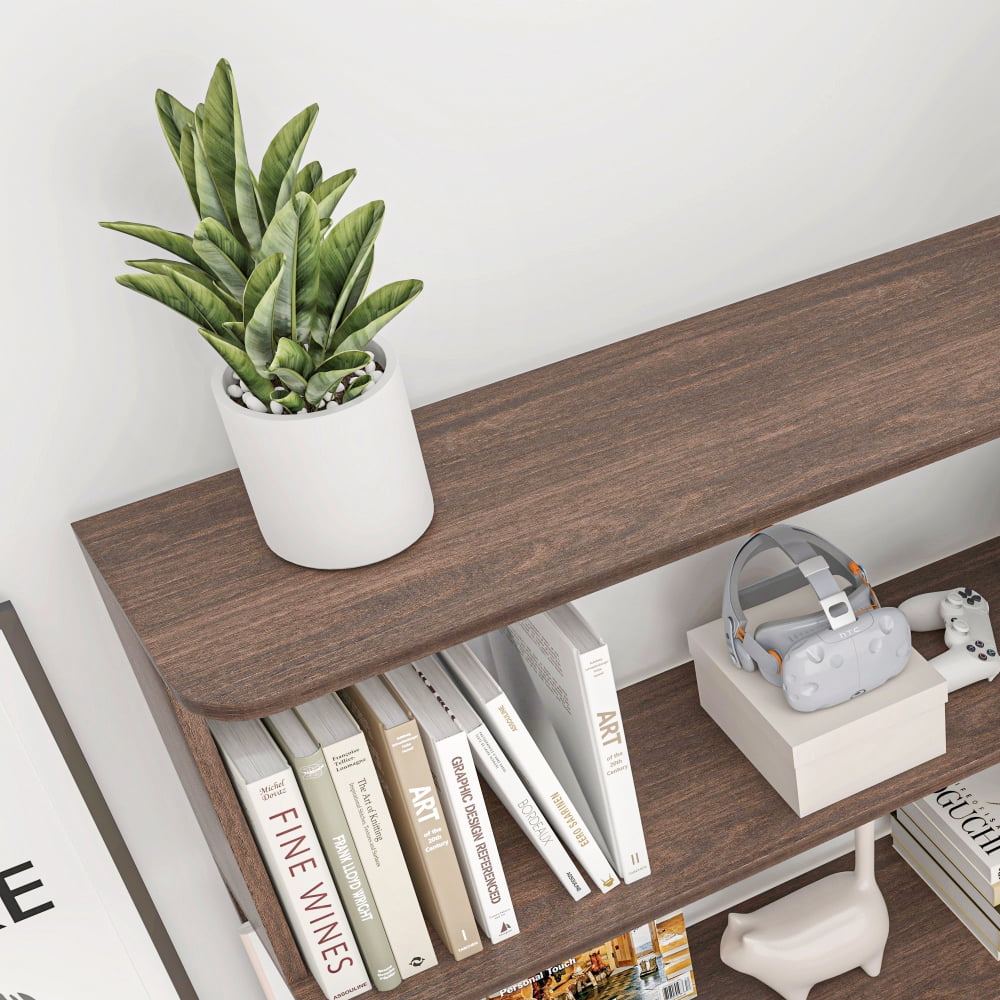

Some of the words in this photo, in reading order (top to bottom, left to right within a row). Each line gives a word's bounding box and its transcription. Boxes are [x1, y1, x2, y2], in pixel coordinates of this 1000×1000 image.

[596, 711, 622, 747] ART
[606, 754, 615, 763] of
[613, 751, 624, 759] the
[606, 765, 628, 777] Century
[258, 779, 286, 796] Michel
[261, 788, 287, 802] Dovaz
[357, 777, 367, 792] The
[362, 794, 371, 806] Art
[369, 812, 383, 843] Knitting
[409, 786, 440, 823] ART
[549, 791, 578, 830] SAARINEN
[424, 830, 432, 839] of
[431, 827, 443, 835] the
[451, 756, 474, 804] GRAPHIC
[464, 803, 484, 843] DESIGN
[475, 841, 501, 904] REFERENCED
[517, 799, 554, 847] BORDEAUX
[574, 826, 590, 848] EERO
[425, 840, 449, 854] Century
[428, 835, 442, 845] 20th
[269, 807, 317, 878] FINE
[300, 881, 354, 974] WINES
[332, 834, 353, 863] FRANK
[343, 861, 361, 890] LLOYD
[352, 888, 373, 922] WRIGHT
[333, 982, 368, 1000] ASSOULINE
[500, 971, 544, 997] Personal
[546, 957, 577, 975] Touch
